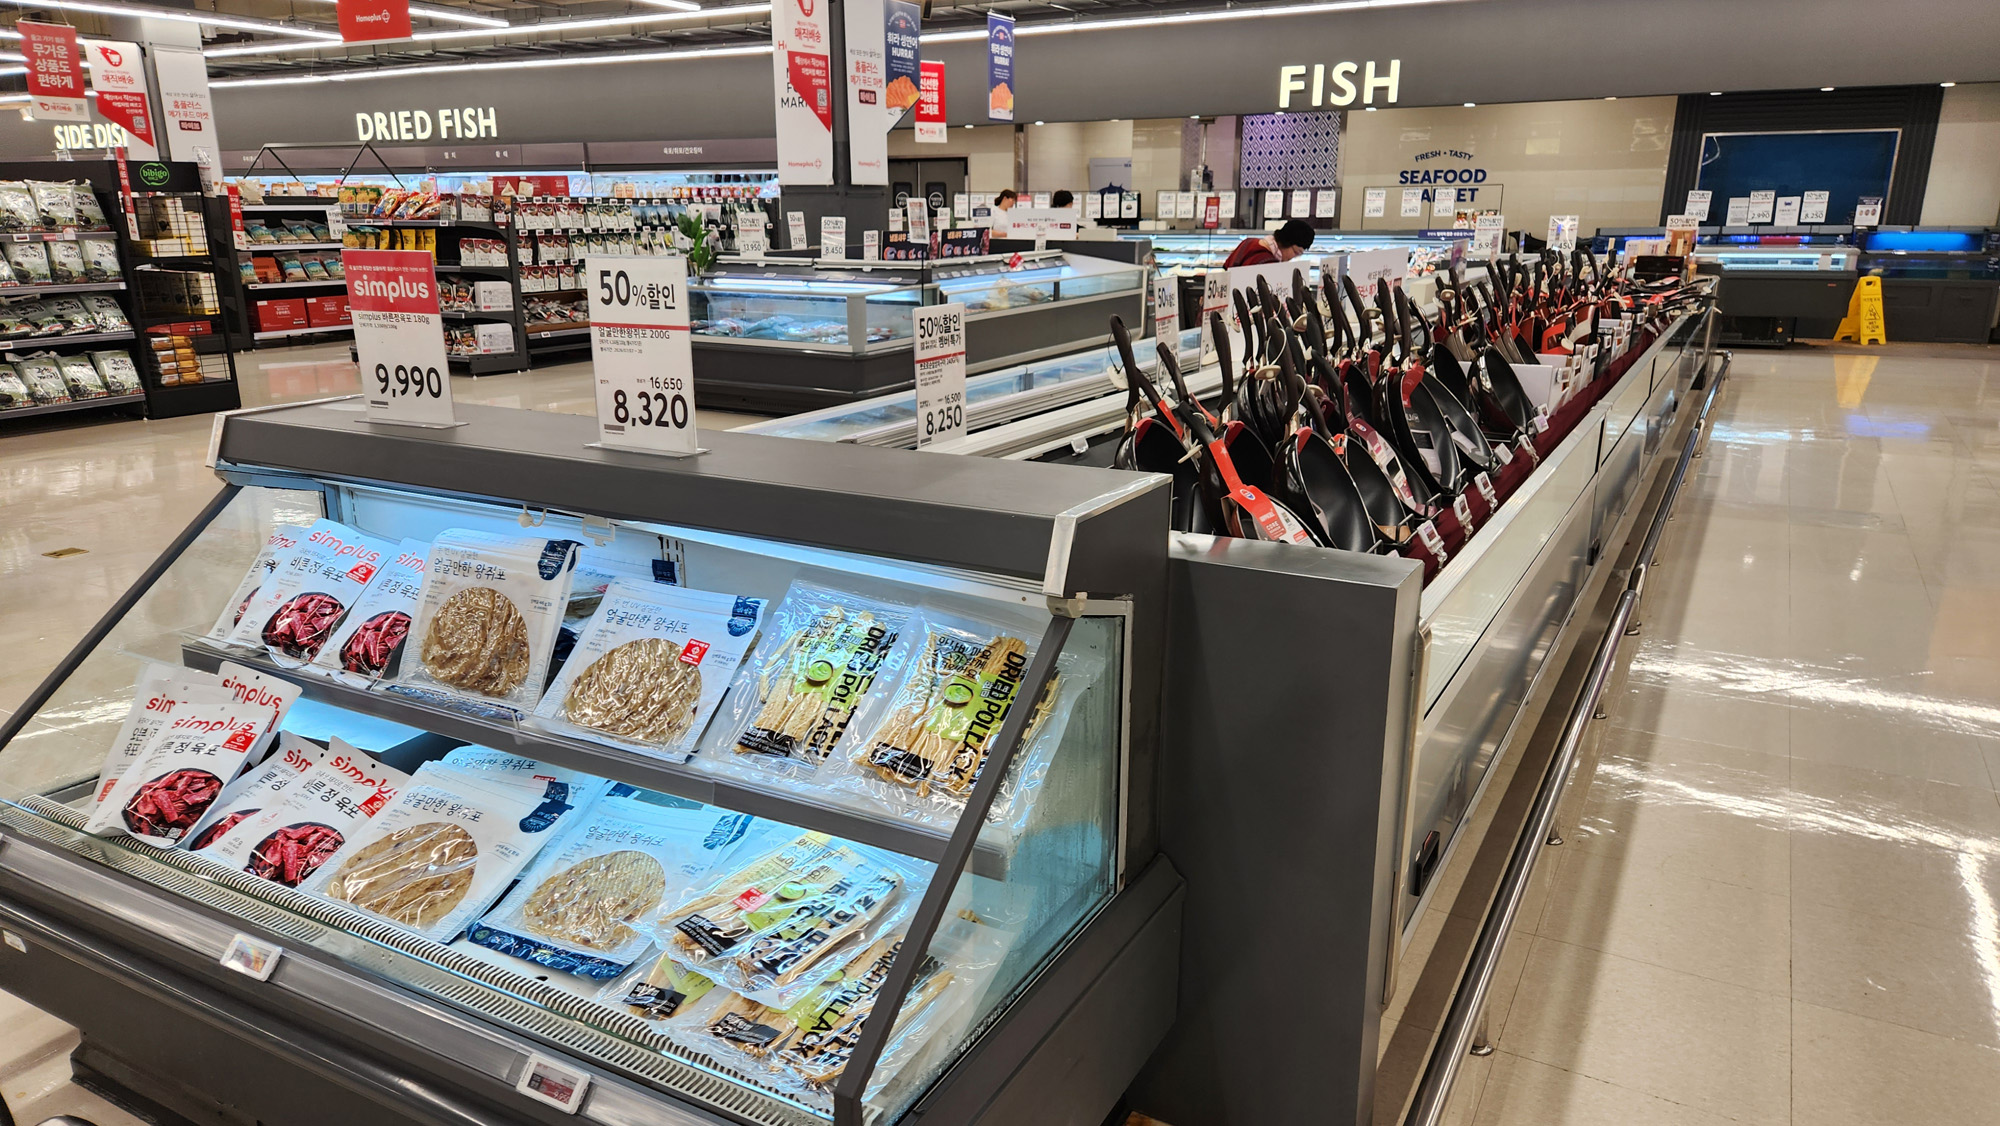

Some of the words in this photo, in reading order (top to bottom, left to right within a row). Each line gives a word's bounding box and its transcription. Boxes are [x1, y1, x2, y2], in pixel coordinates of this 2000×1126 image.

[32, 43, 68, 58] 무거운
[901, 34, 918, 49] 생연어
[892, 47, 914, 59] HURRA!
[35, 58, 71, 73] 상품도
[855, 60, 878, 74] 홈플러스
[37, 73, 73, 88] 편하게
[1278, 58, 1400, 109] FISH
[173, 100, 202, 110] 홈플러스
[920, 103, 939, 115] 그대로
[356, 110, 403, 141] DRIED
[438, 106, 498, 139] FISH
[54, 124, 94, 150] SIDE
[1414, 150, 1441, 163] FRESH
[1449, 149, 1474, 161] TASTY
[142, 169, 168, 179] bibigo
[1399, 168, 1487, 184] SEAFOOD
[354, 274, 429, 303] simplus
[599, 268, 677, 311] 50%할인
[1207, 280, 1229, 301] 50%할인
[358, 312, 381, 321] simplus
[381, 312, 413, 324] 바른정육포
[413, 315, 430, 325] 180g
[919, 312, 961, 340] 50%할인
[598, 326, 648, 340] 얼굴만한왕쥐포
[650, 329, 670, 339] 200G
[938, 332, 962, 349] 멤버특가
[375, 363, 443, 399] 9,990
[649, 376, 683, 391] 16,650
[944, 391, 961, 405] 16,500
[614, 389, 688, 430] 8,320
[926, 404, 962, 436] 8,250
[308, 529, 381, 563] simplus
[433, 557, 472, 578] 얼굴만한
[474, 563, 507, 582] 왕쥐포
[606, 607, 651, 629] 얼굴만한
[653, 616, 690, 635] 왕쥐포
[222, 675, 283, 710] simplus
[171, 715, 257, 734] simplus
[499, 758, 537, 771] 왕쥐포
[402, 791, 449, 815] 얼굴만한
[585, 824, 632, 844] 얼굴만한
[630, 832, 668, 848] 왕쥐포
